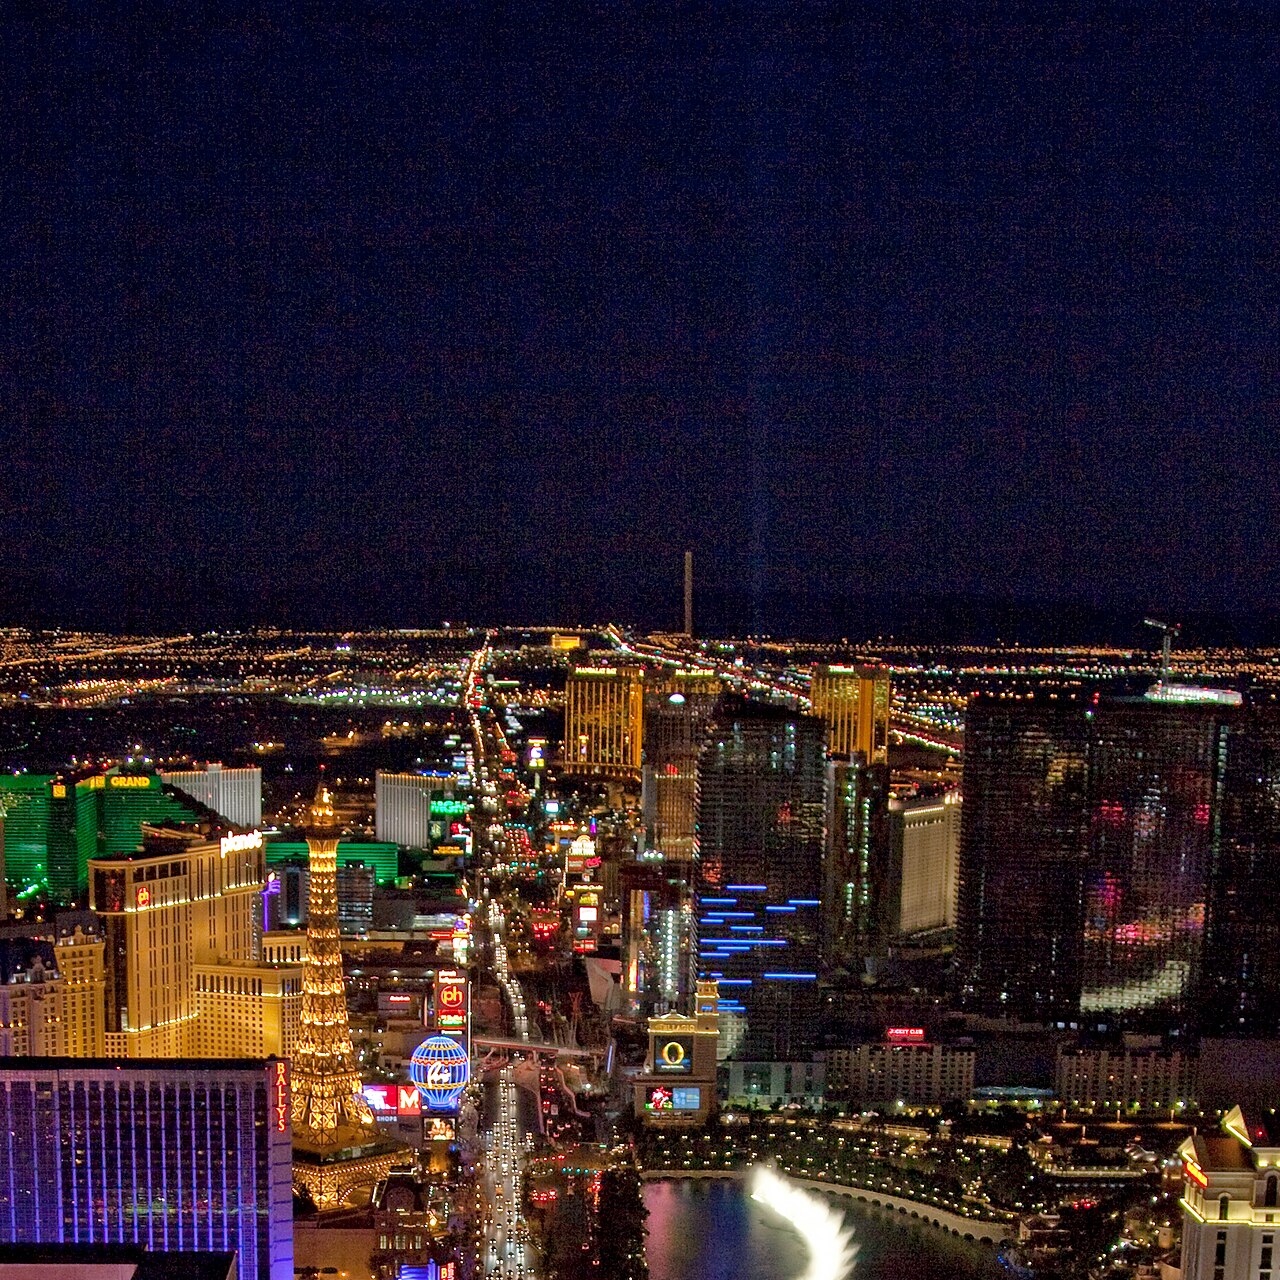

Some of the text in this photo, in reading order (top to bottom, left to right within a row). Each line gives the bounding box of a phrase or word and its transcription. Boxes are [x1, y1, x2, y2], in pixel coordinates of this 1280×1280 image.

[110, 776, 151, 787] GRAND
[221, 829, 263, 859] planet
[443, 986, 463, 1004] ph
